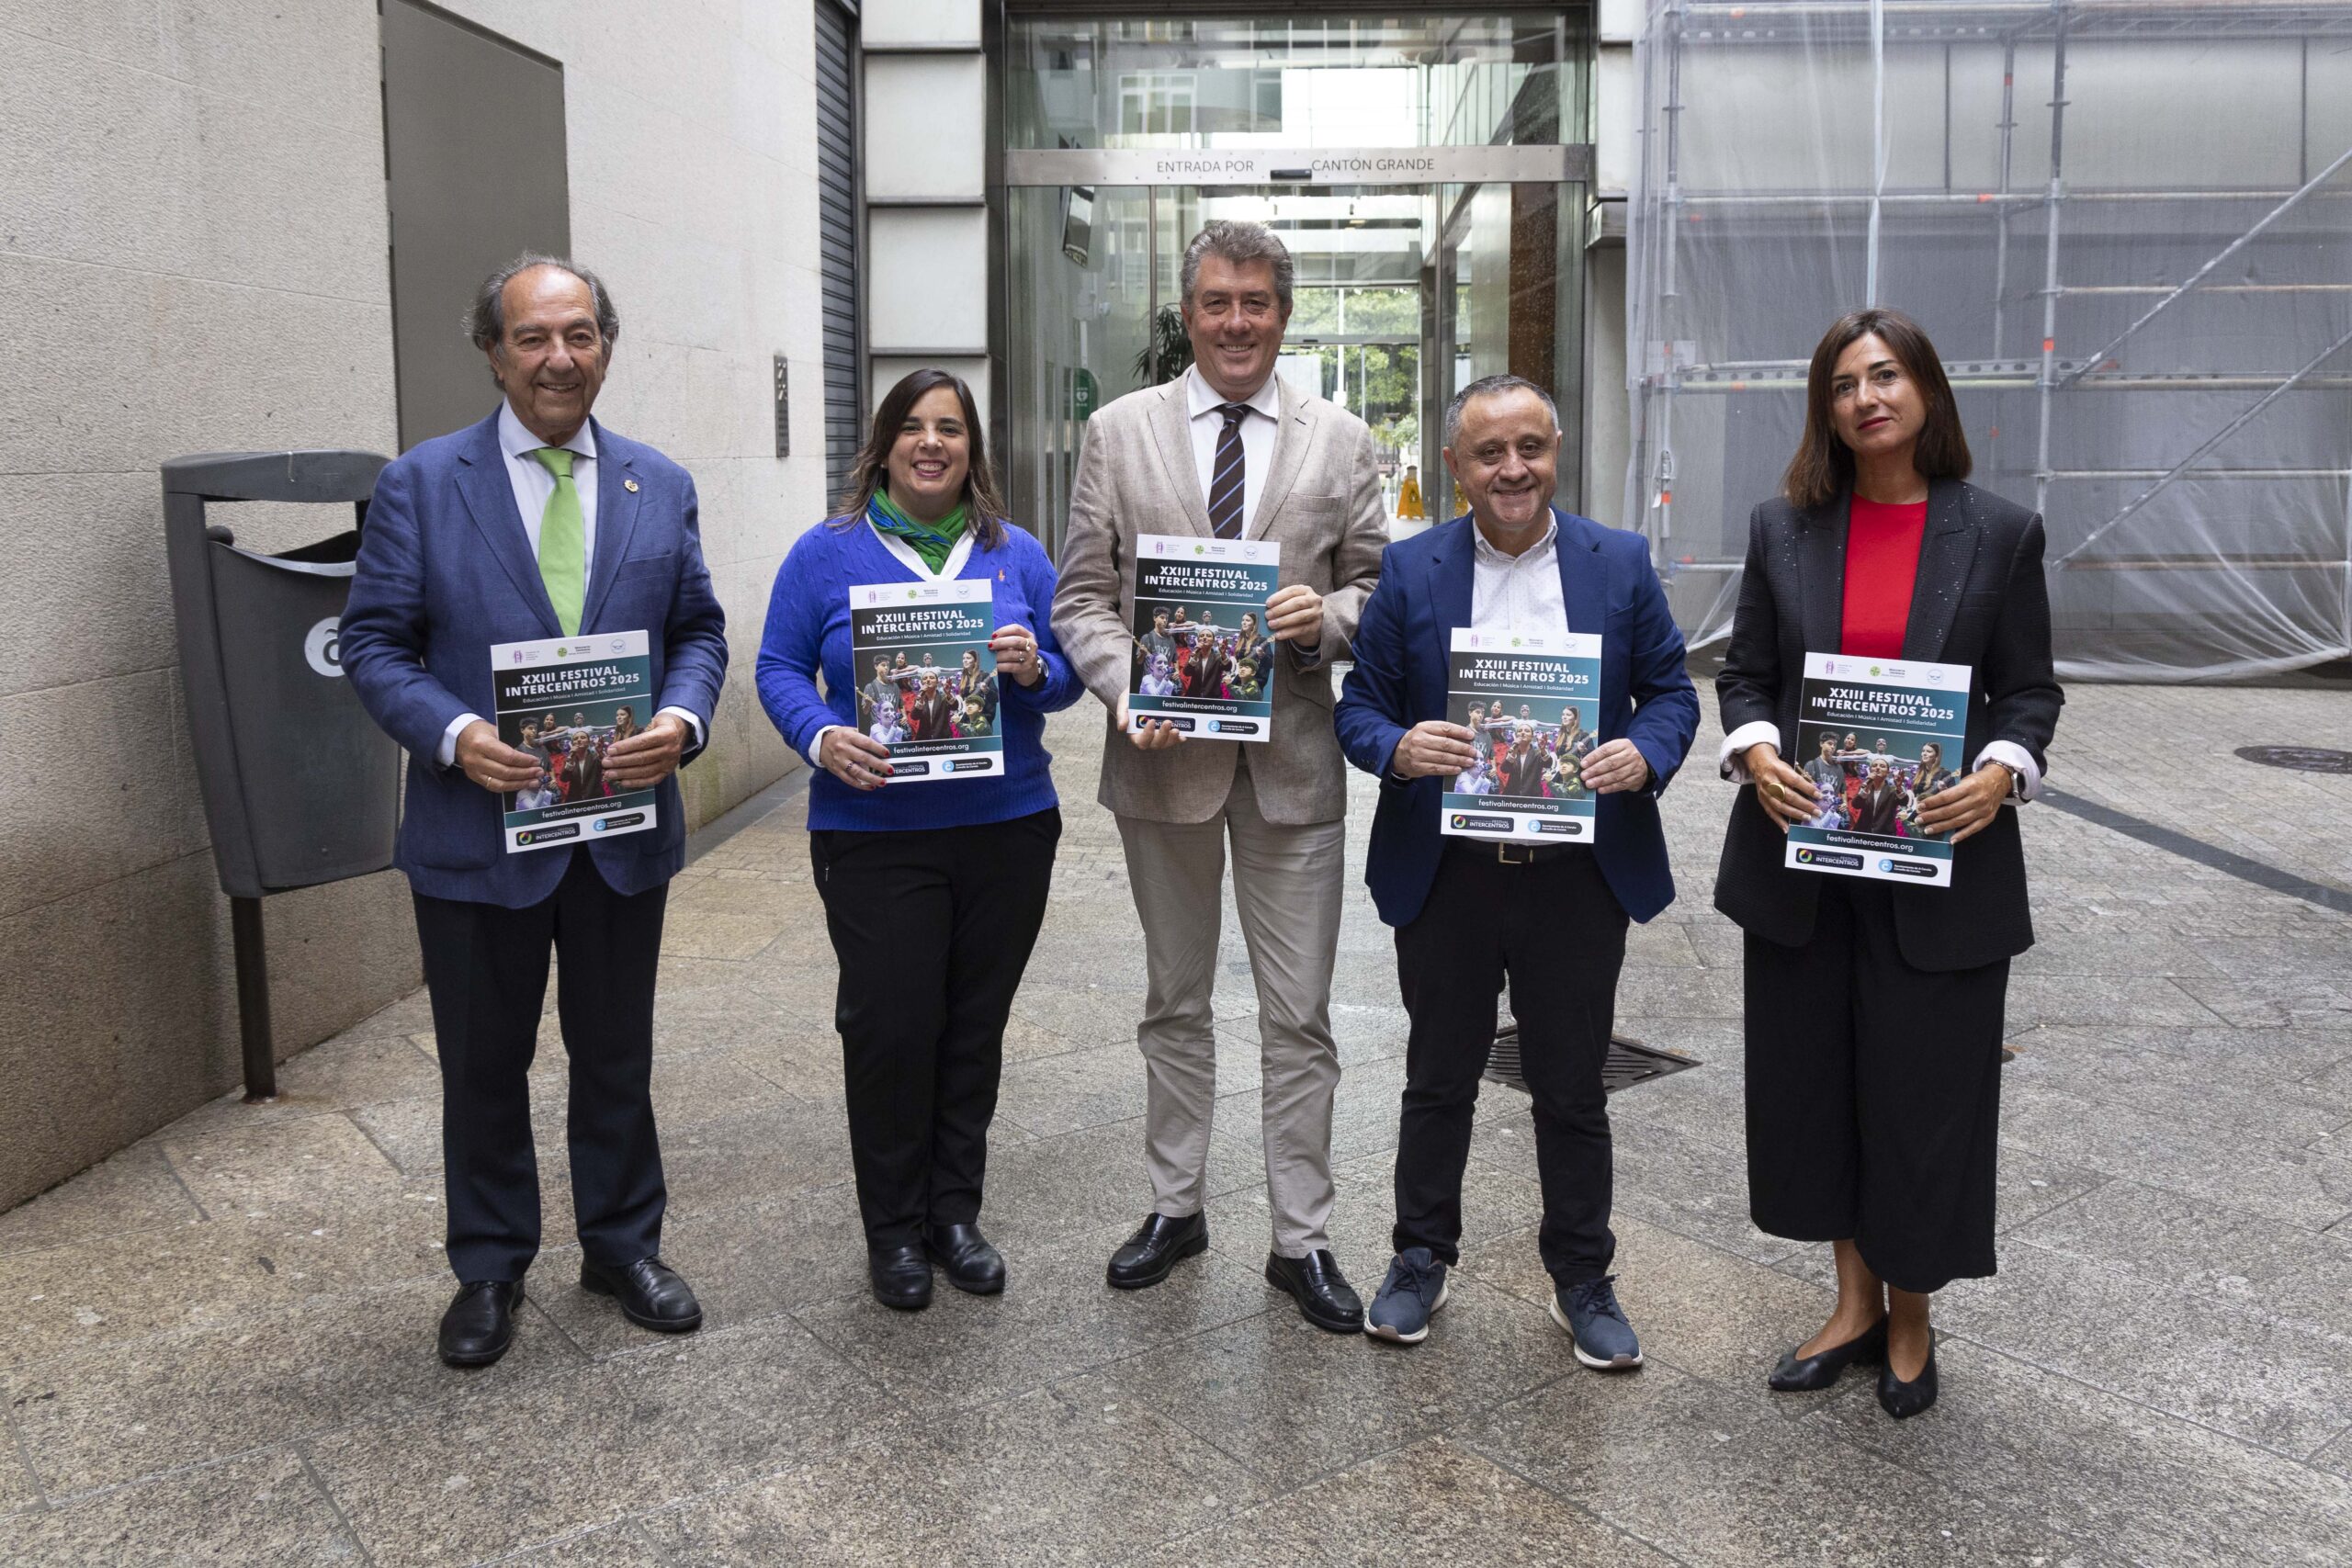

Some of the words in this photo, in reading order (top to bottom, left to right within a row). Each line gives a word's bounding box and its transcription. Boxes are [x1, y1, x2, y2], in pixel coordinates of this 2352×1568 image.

[1157, 162, 1221, 173] ENTRADA
[1226, 161, 1254, 172] POR
[1312, 157, 1372, 172] CANTÓN
[1376, 158, 1434, 171] GRANDE
[1160, 566, 1190, 577] XXIII
[1194, 568, 1250, 580] FESTIVAL
[1145, 575, 1236, 589] INTERCENTROS
[1239, 581, 1268, 591] 2025
[876, 613, 906, 623] XXIII
[910, 610, 965, 621] FESTIVAL
[862, 621, 953, 634] INTERCENTROS
[956, 619, 984, 628] 2025
[1476, 660, 1507, 670] XXIII
[1511, 661, 1569, 672] FESTIVAL
[522, 672, 555, 685] XXIII
[560, 666, 619, 680] FESTIVAL
[1459, 670, 1555, 682] INTERCENTROS
[1559, 674, 1589, 684] 2025
[506, 677, 606, 697] INTERCENTROS
[610, 673, 639, 685] 2025
[1830, 688, 1863, 699] XXIII
[1869, 692, 1932, 706] FESTIVAL
[1162, 700, 1237, 713] festivalintercentros.org
[1812, 697, 1917, 716] INTERCENTROS
[1921, 707, 1954, 719] 2025
[1826, 711, 1854, 719] Educación
[894, 744, 969, 754] festivalintercentros.org
[542, 801, 621, 818] festivalintercentros.org
[1478, 799, 1558, 811] festivalintercentros.org
[1827, 834, 1914, 852] festivalintercentros.org
